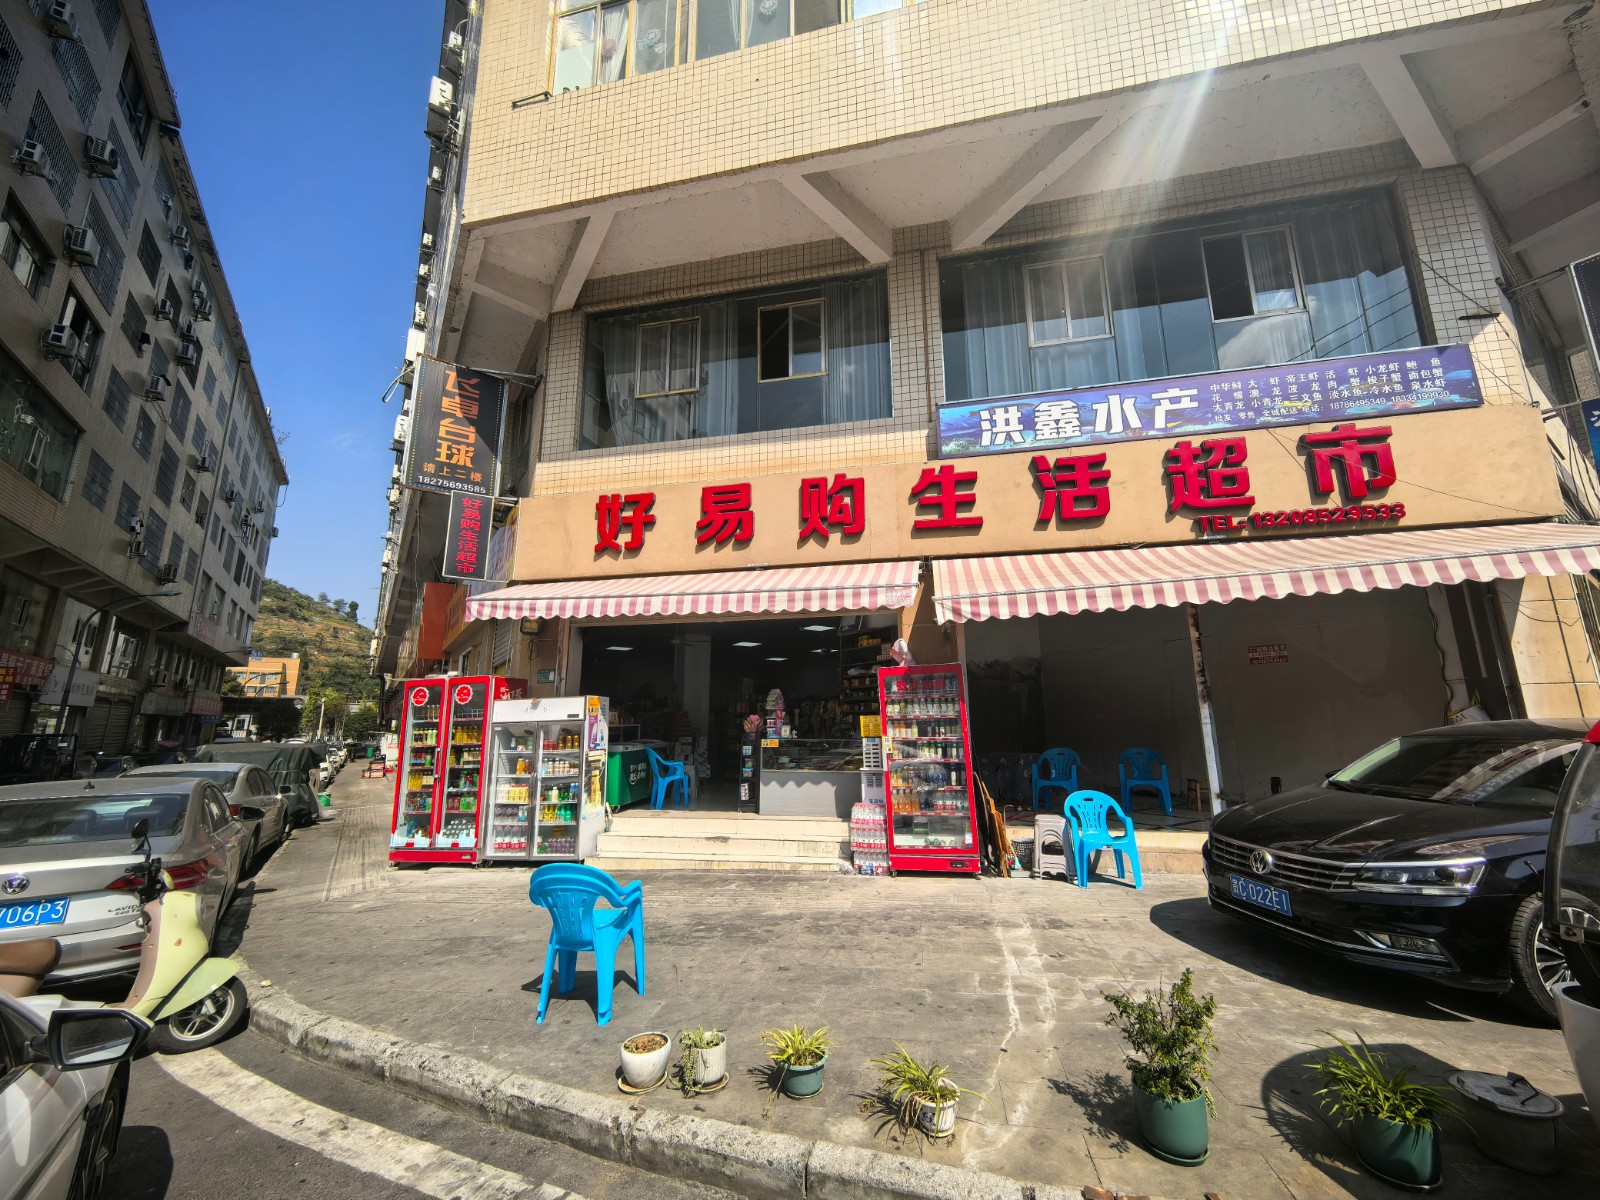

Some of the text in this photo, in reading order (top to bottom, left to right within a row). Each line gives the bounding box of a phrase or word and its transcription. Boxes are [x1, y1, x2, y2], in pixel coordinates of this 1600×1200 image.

[1286, 371, 1319, 383] 帝王虾
[1365, 362, 1400, 374] 小龙虾
[1213, 401, 1246, 412] 大青龙
[1251, 396, 1284, 408] 小青龙
[1289, 392, 1323, 404] 三文鱼
[1329, 388, 1362, 400] 淡水鱼
[980, 388, 1199, 447] 洪鑫水产
[418, 475, 486, 494] 18275693585
[594, 423, 1398, 553] 好易购生活超市
[1251, 502, 1407, 528] 13208529533
[456, 497, 483, 574] 好易购生活超市
